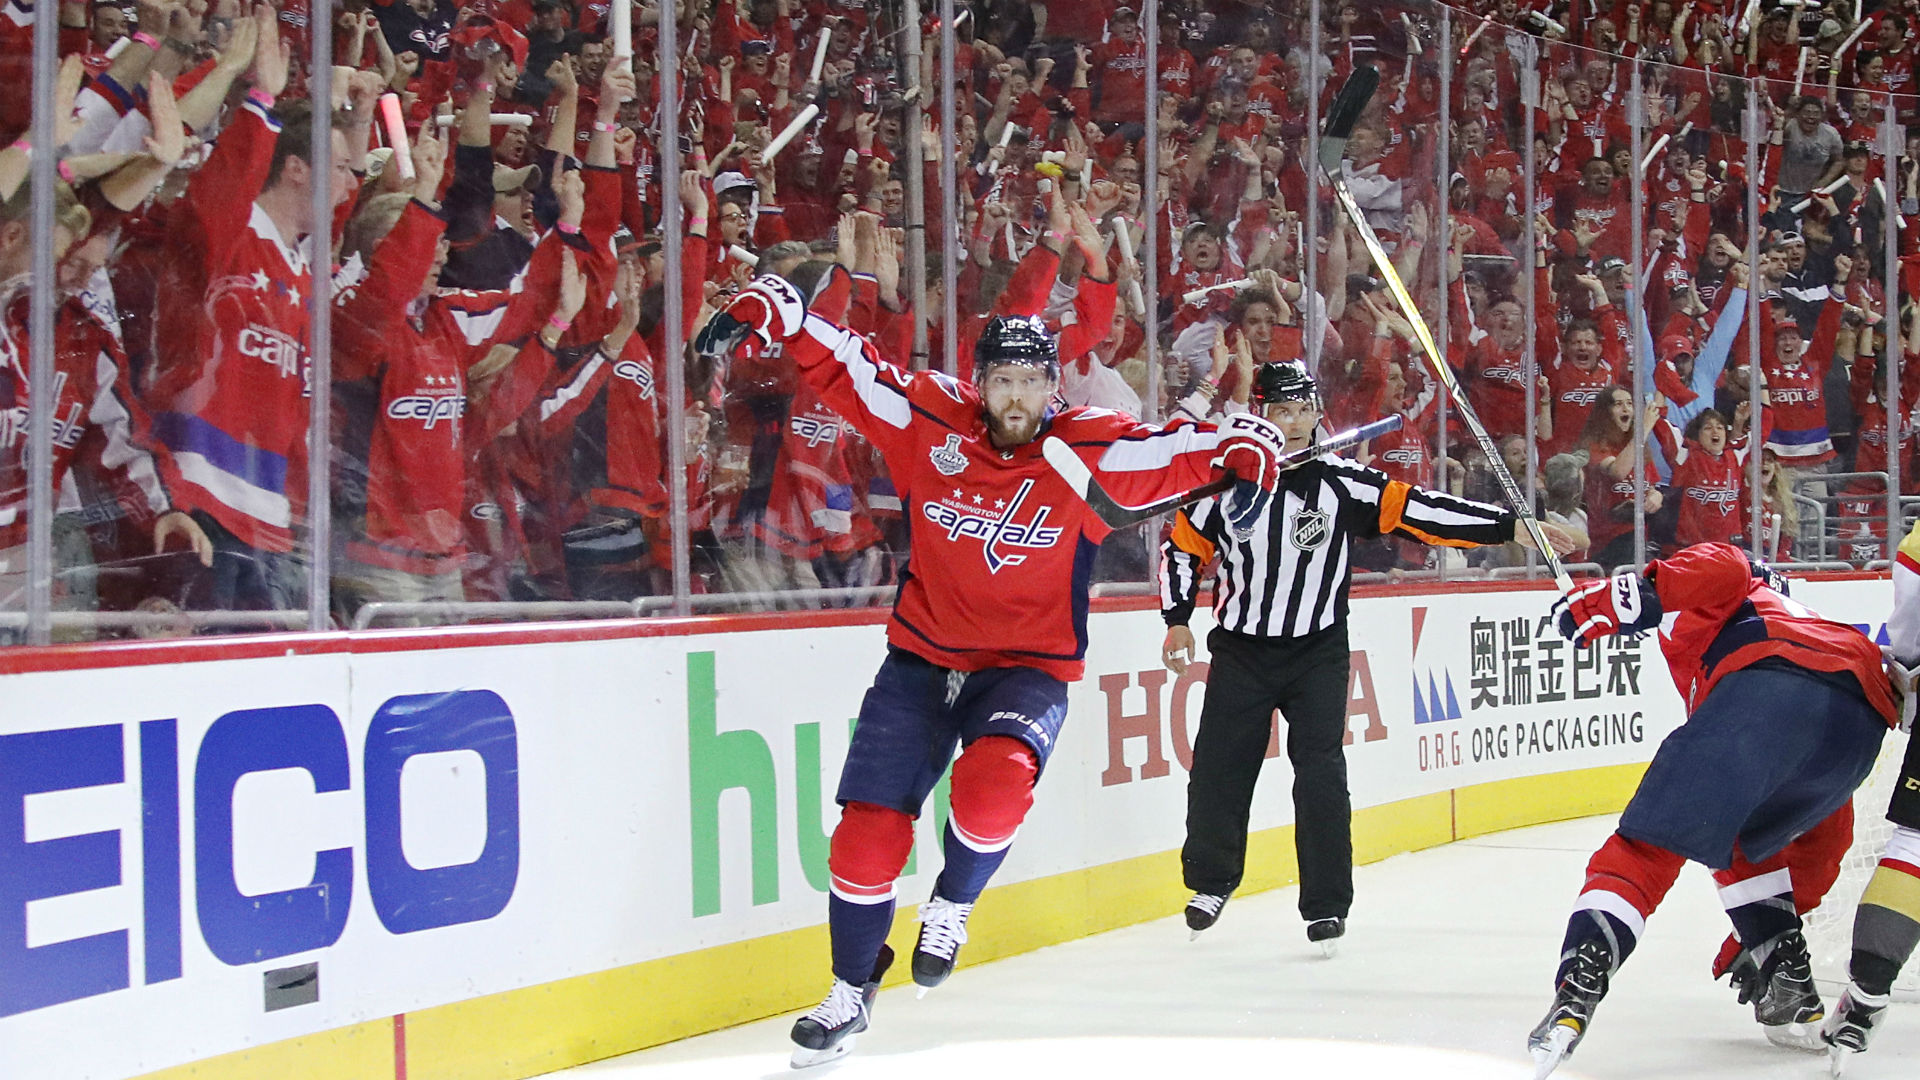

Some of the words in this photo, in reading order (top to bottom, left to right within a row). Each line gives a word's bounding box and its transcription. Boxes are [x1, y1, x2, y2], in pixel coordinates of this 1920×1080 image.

[1231, 417, 1283, 449] CCM
[940, 497, 1002, 519] WASHINGTON
[922, 478, 1065, 575] capitals
[1299, 520, 1322, 544] NHL
[1617, 575, 1633, 612] CM
[1472, 724, 1508, 763] ORG
[1516, 710, 1644, 756] PACKAGING
